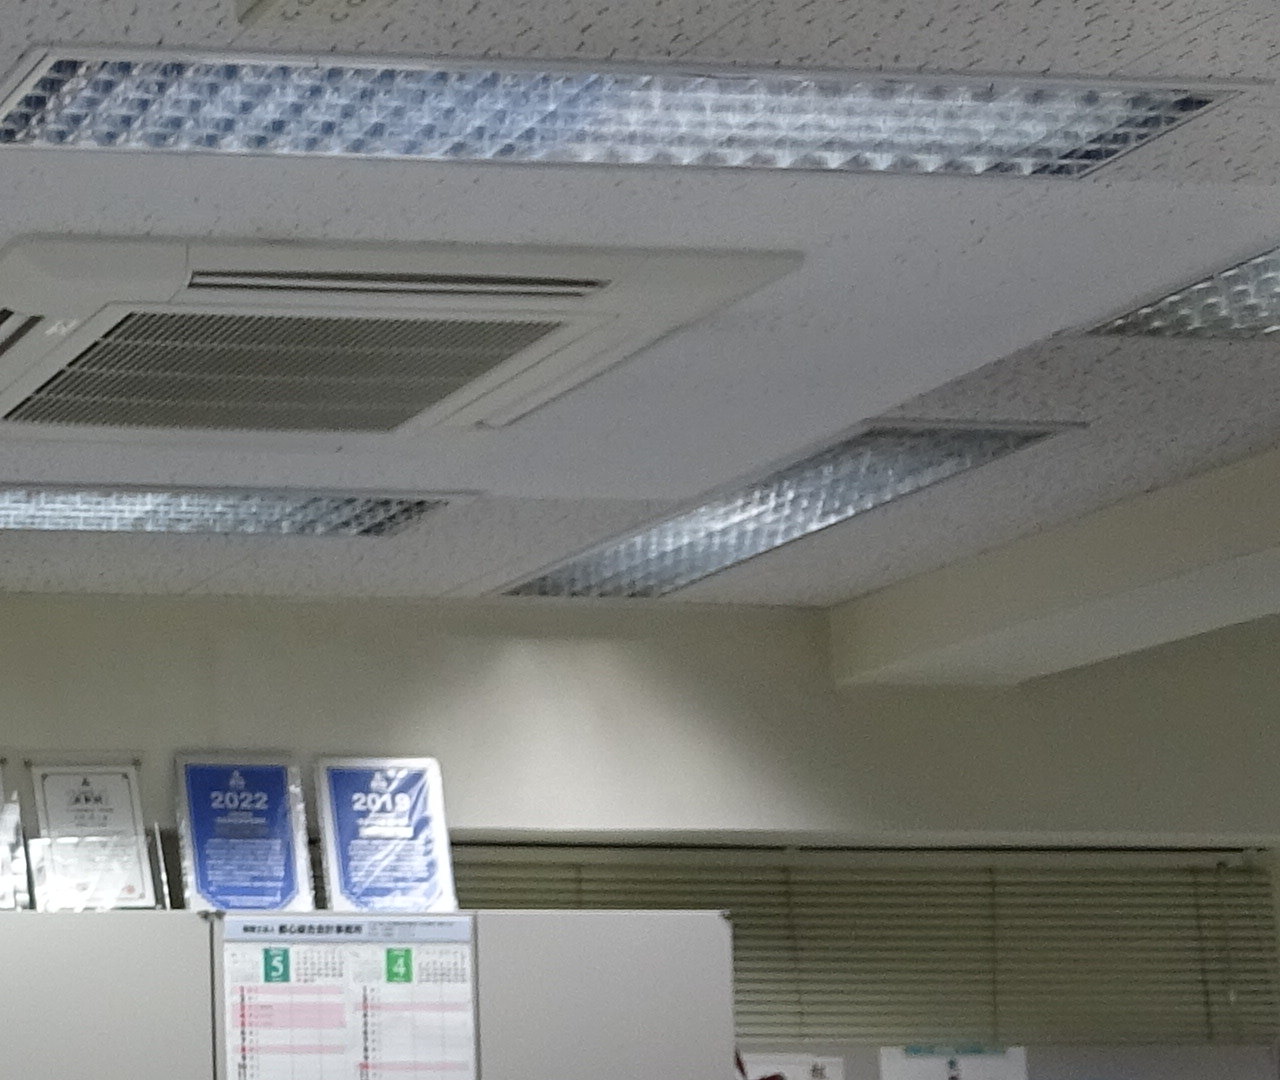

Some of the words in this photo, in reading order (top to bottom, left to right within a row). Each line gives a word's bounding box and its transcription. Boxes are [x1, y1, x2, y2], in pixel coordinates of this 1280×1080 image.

[210, 791, 269, 810] 2022
[352, 793, 411, 812] 2019
[270, 955, 284, 977] 5
[392, 957, 406, 977] 4
